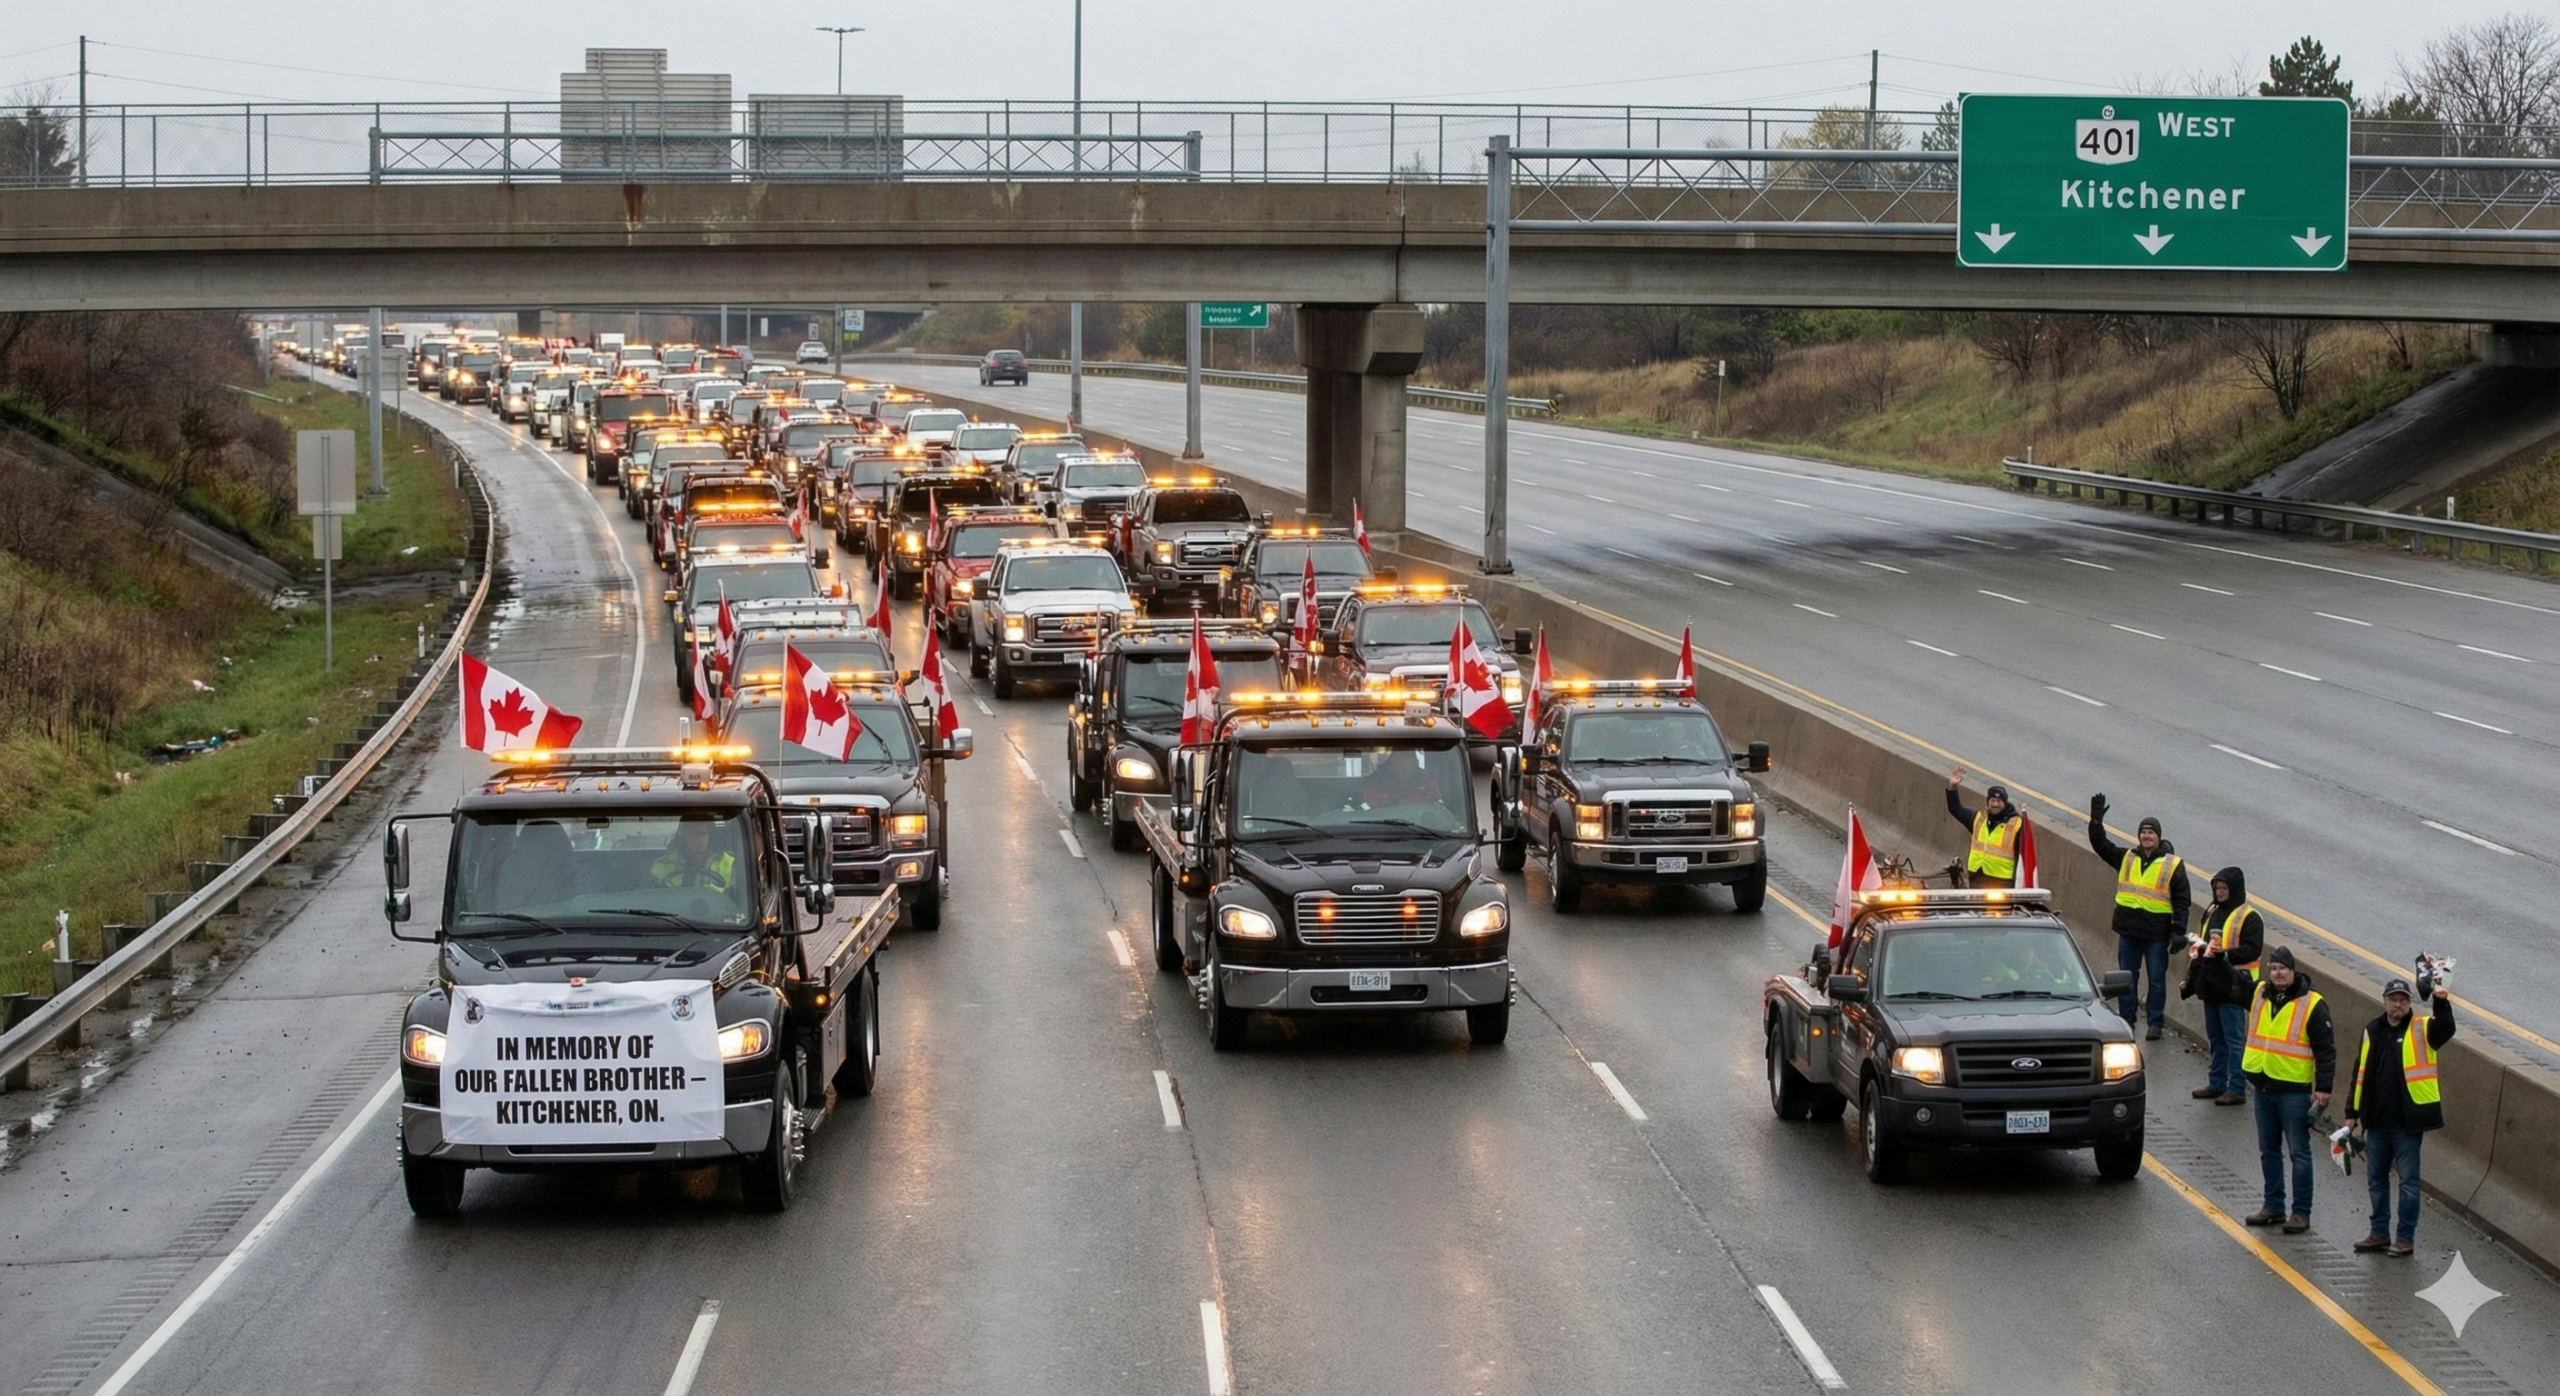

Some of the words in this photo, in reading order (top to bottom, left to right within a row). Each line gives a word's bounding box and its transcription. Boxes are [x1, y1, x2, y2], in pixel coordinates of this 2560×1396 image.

[2080, 128, 2134, 156] 401
[2158, 112, 2235, 137] WEST
[2062, 180, 2245, 210] Kitchener
[497, 1038, 518, 1060] IN
[526, 1036, 621, 1060] MEMORY
[628, 1035, 653, 1059] OF
[456, 1069, 497, 1092] OUR
[504, 1069, 577, 1092] FALLEN
[584, 1067, 685, 1091] BROTHER
[497, 1100, 622, 1125] KITCHENER,
[629, 1099, 664, 1122] ON.
